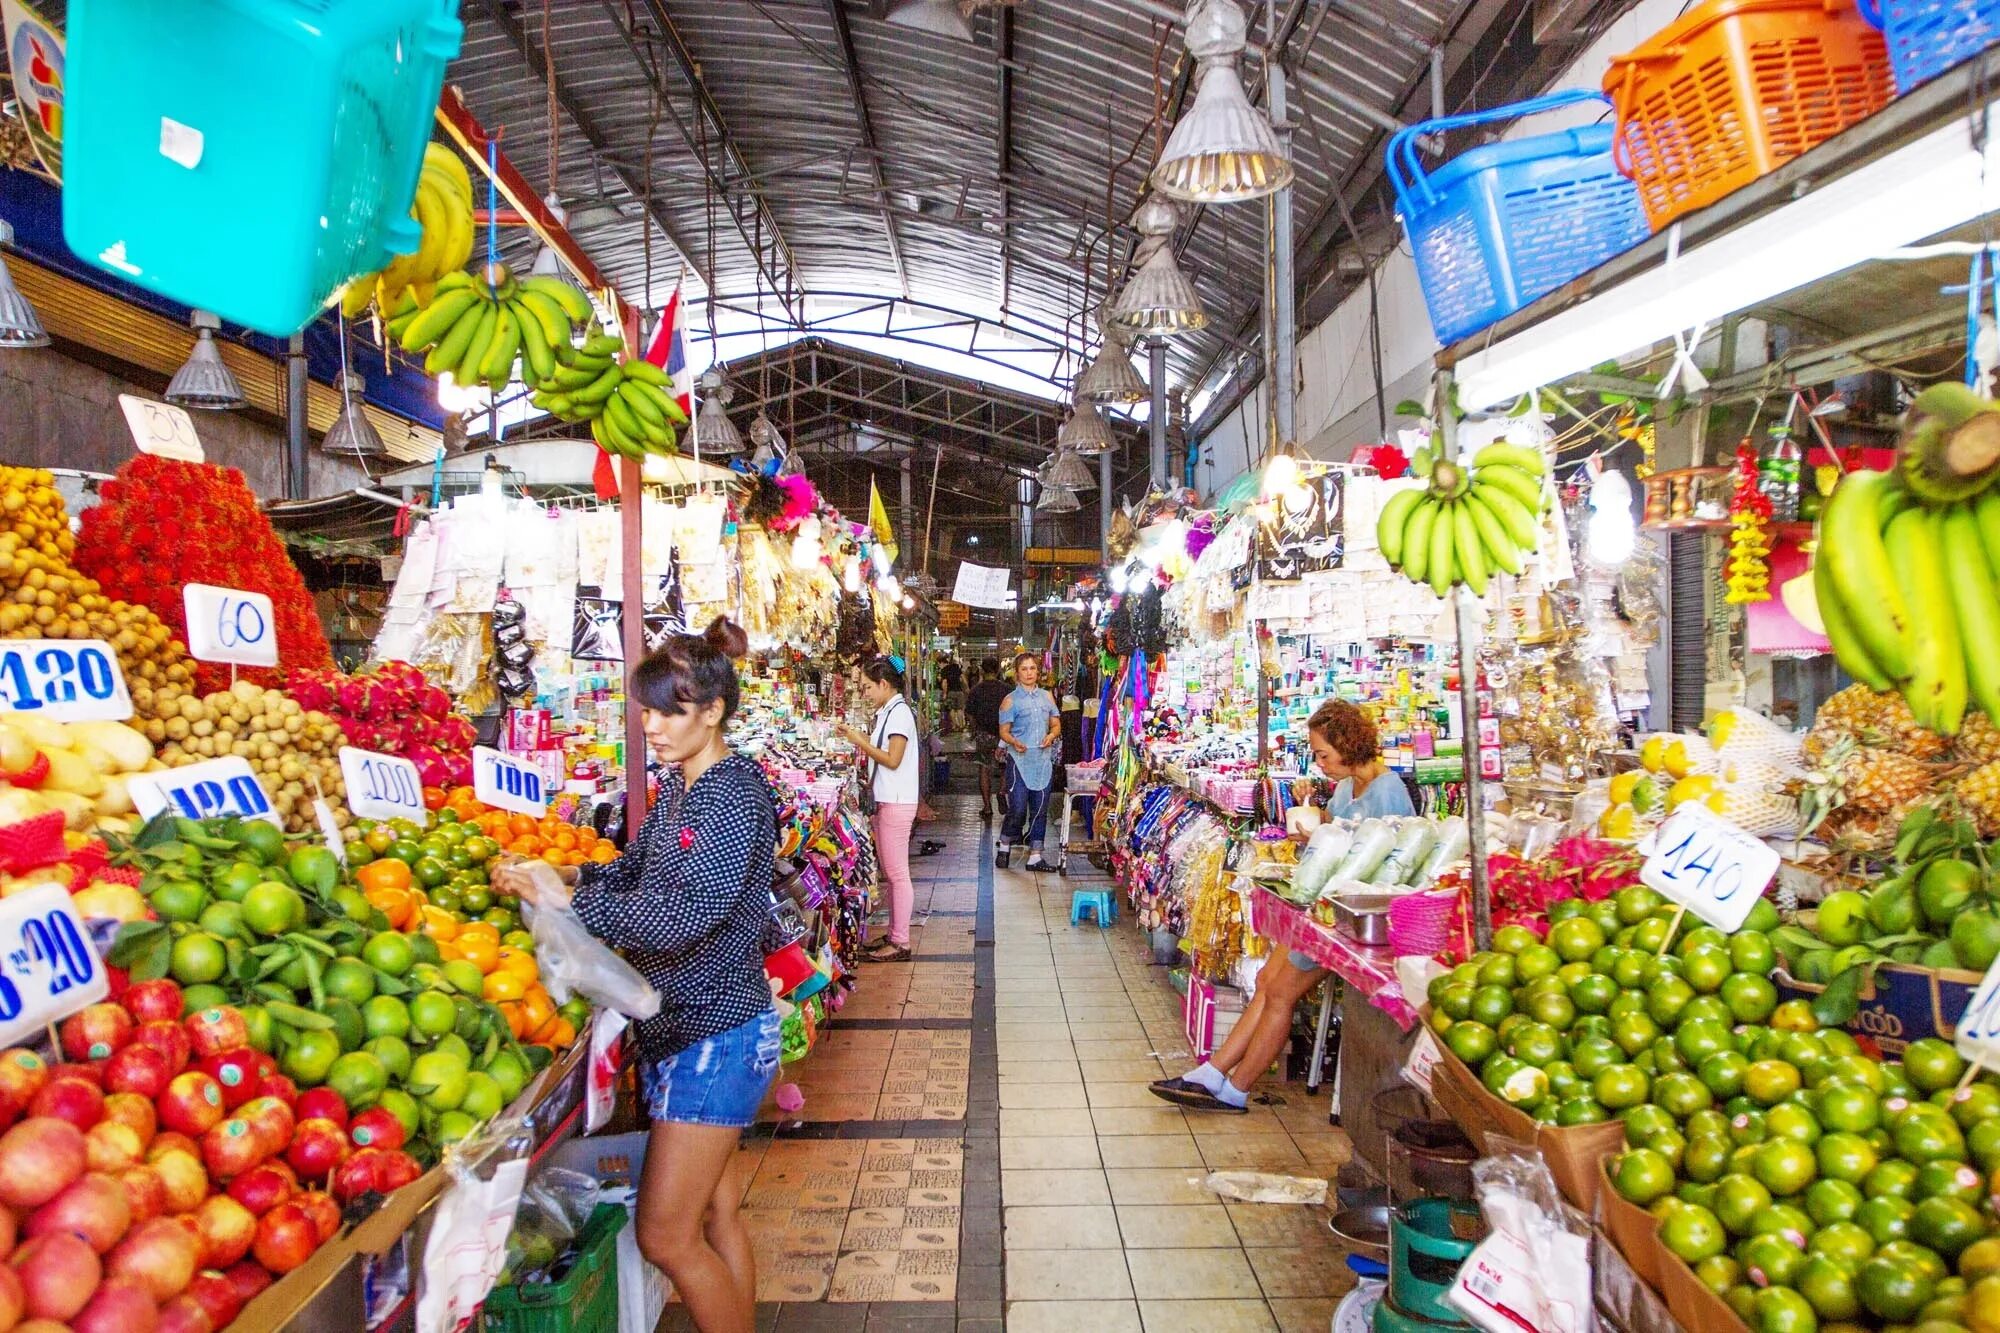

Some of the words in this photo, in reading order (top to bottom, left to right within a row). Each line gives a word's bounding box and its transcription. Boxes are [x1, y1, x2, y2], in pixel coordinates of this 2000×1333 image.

[218, 597, 264, 648] 60
[0, 648, 114, 710] 120
[170, 776, 269, 820] 120
[361, 760, 418, 807] 100
[496, 763, 540, 803] 100
[1662, 832, 1743, 901] 140
[21, 910, 93, 995] 20
